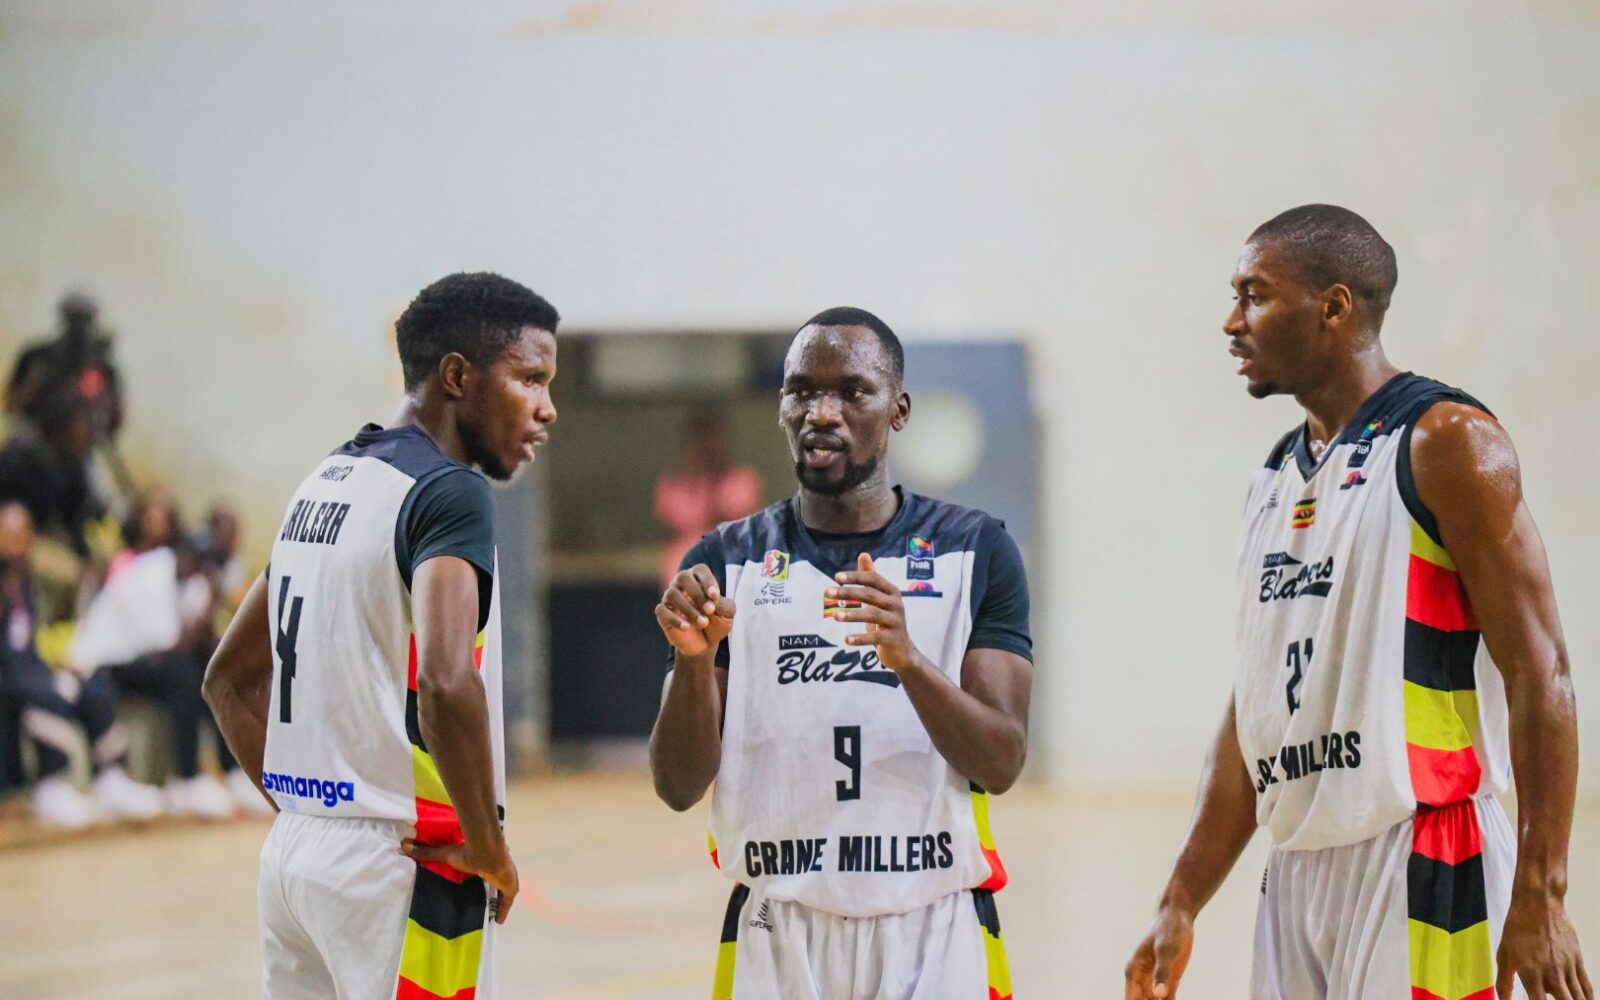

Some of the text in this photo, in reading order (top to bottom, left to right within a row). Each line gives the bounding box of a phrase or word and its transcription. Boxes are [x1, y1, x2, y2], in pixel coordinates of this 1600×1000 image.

[276, 575, 304, 724] 4
[781, 635, 819, 647] NAM
[776, 649, 901, 689] Blaze
[833, 725, 861, 802] 9
[745, 831, 954, 878] CRANE MILLERS
